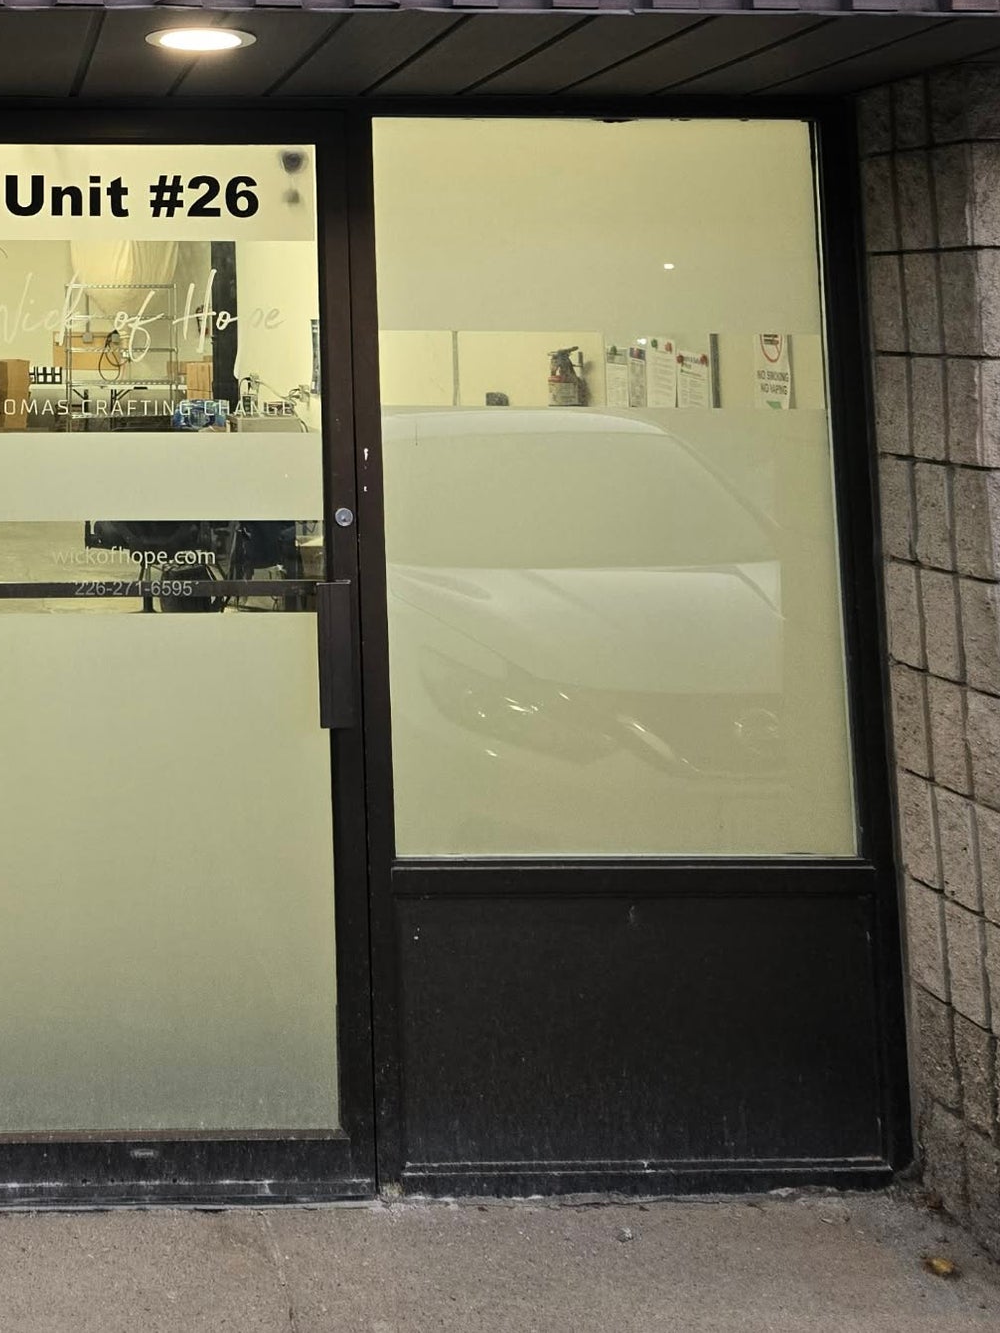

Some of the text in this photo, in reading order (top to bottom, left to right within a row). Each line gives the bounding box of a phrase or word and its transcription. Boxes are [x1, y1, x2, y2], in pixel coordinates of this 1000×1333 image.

[5, 174, 259, 218] Unit #26
[114, 289, 165, 362] of
[81, 398, 191, 416] CRAFTING
[203, 398, 293, 416] CHANGE
[52, 546, 216, 569] wickofhope.com
[74, 580, 193, 597] 226-271-6595
